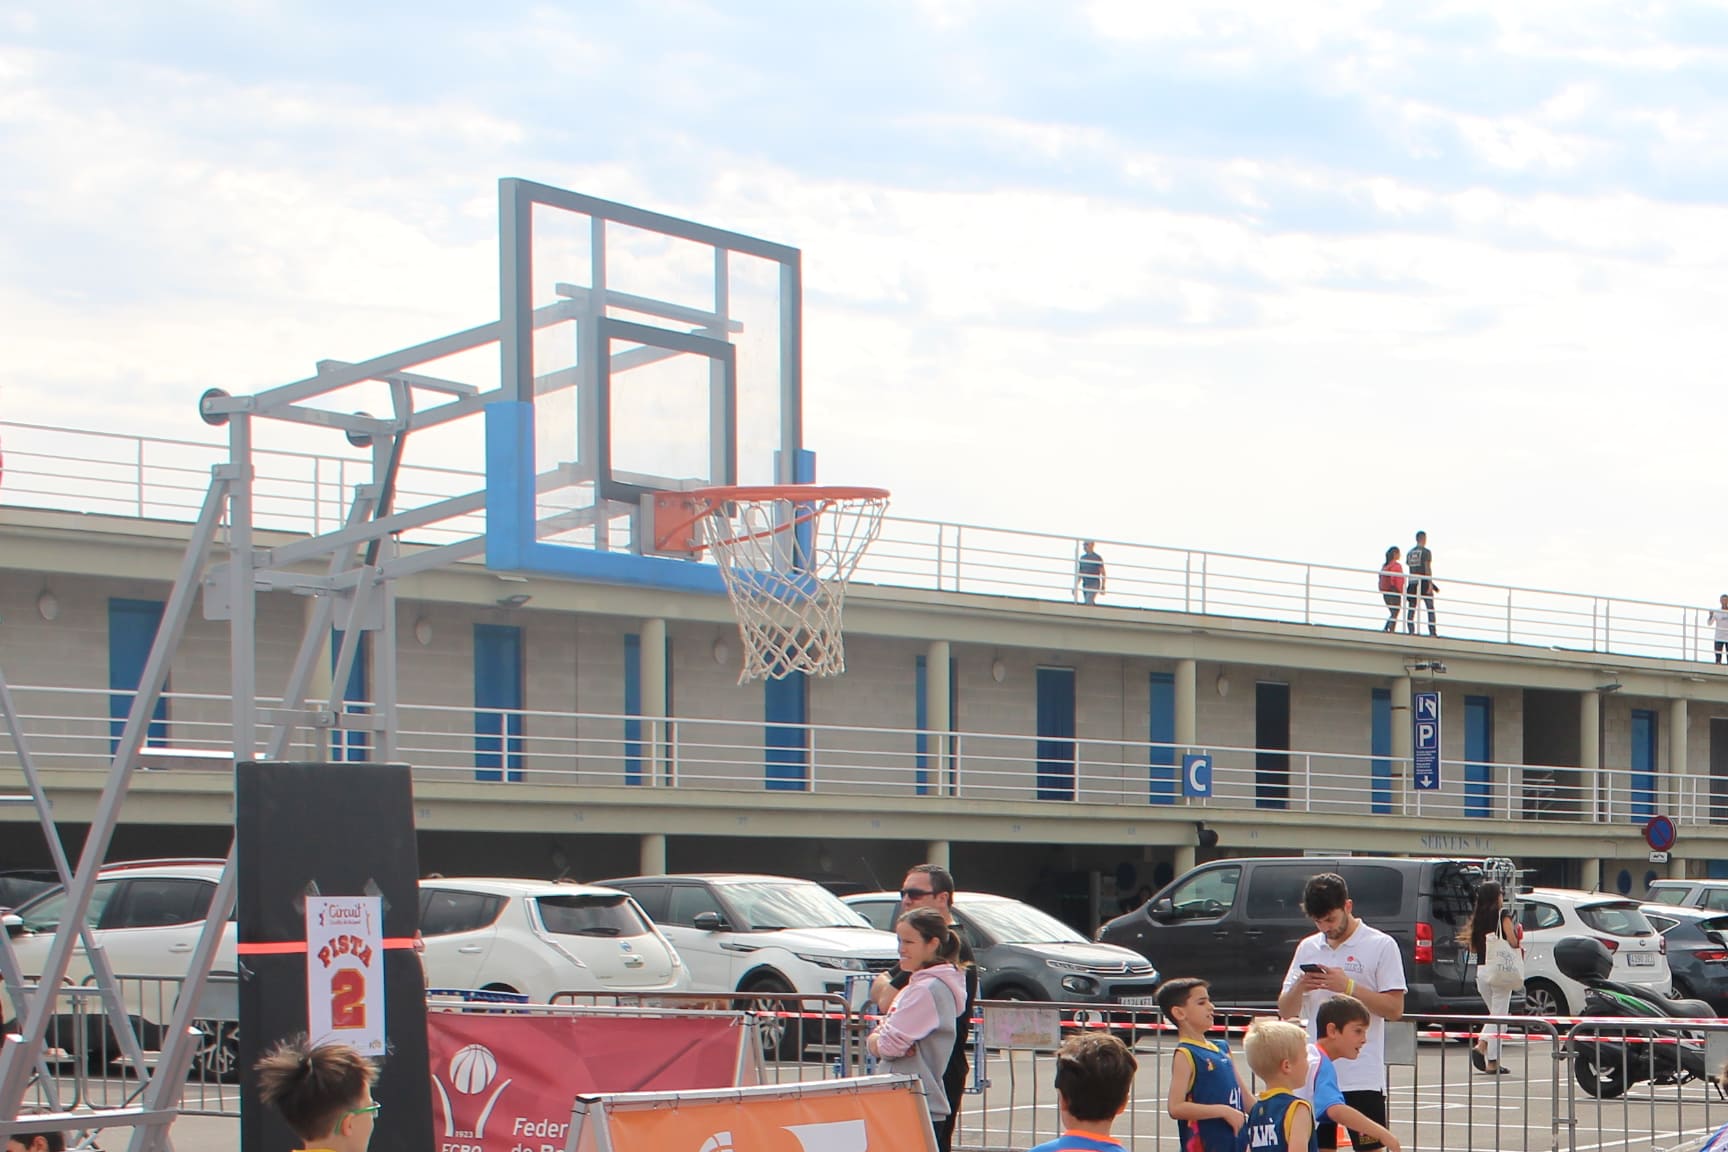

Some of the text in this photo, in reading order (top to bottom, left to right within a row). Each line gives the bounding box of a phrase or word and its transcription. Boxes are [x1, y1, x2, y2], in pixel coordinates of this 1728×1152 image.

[1189, 760, 1207, 791] C
[317, 934, 373, 969] PISTA
[331, 967, 367, 1031] 2
[512, 1116, 569, 1138] Feder
